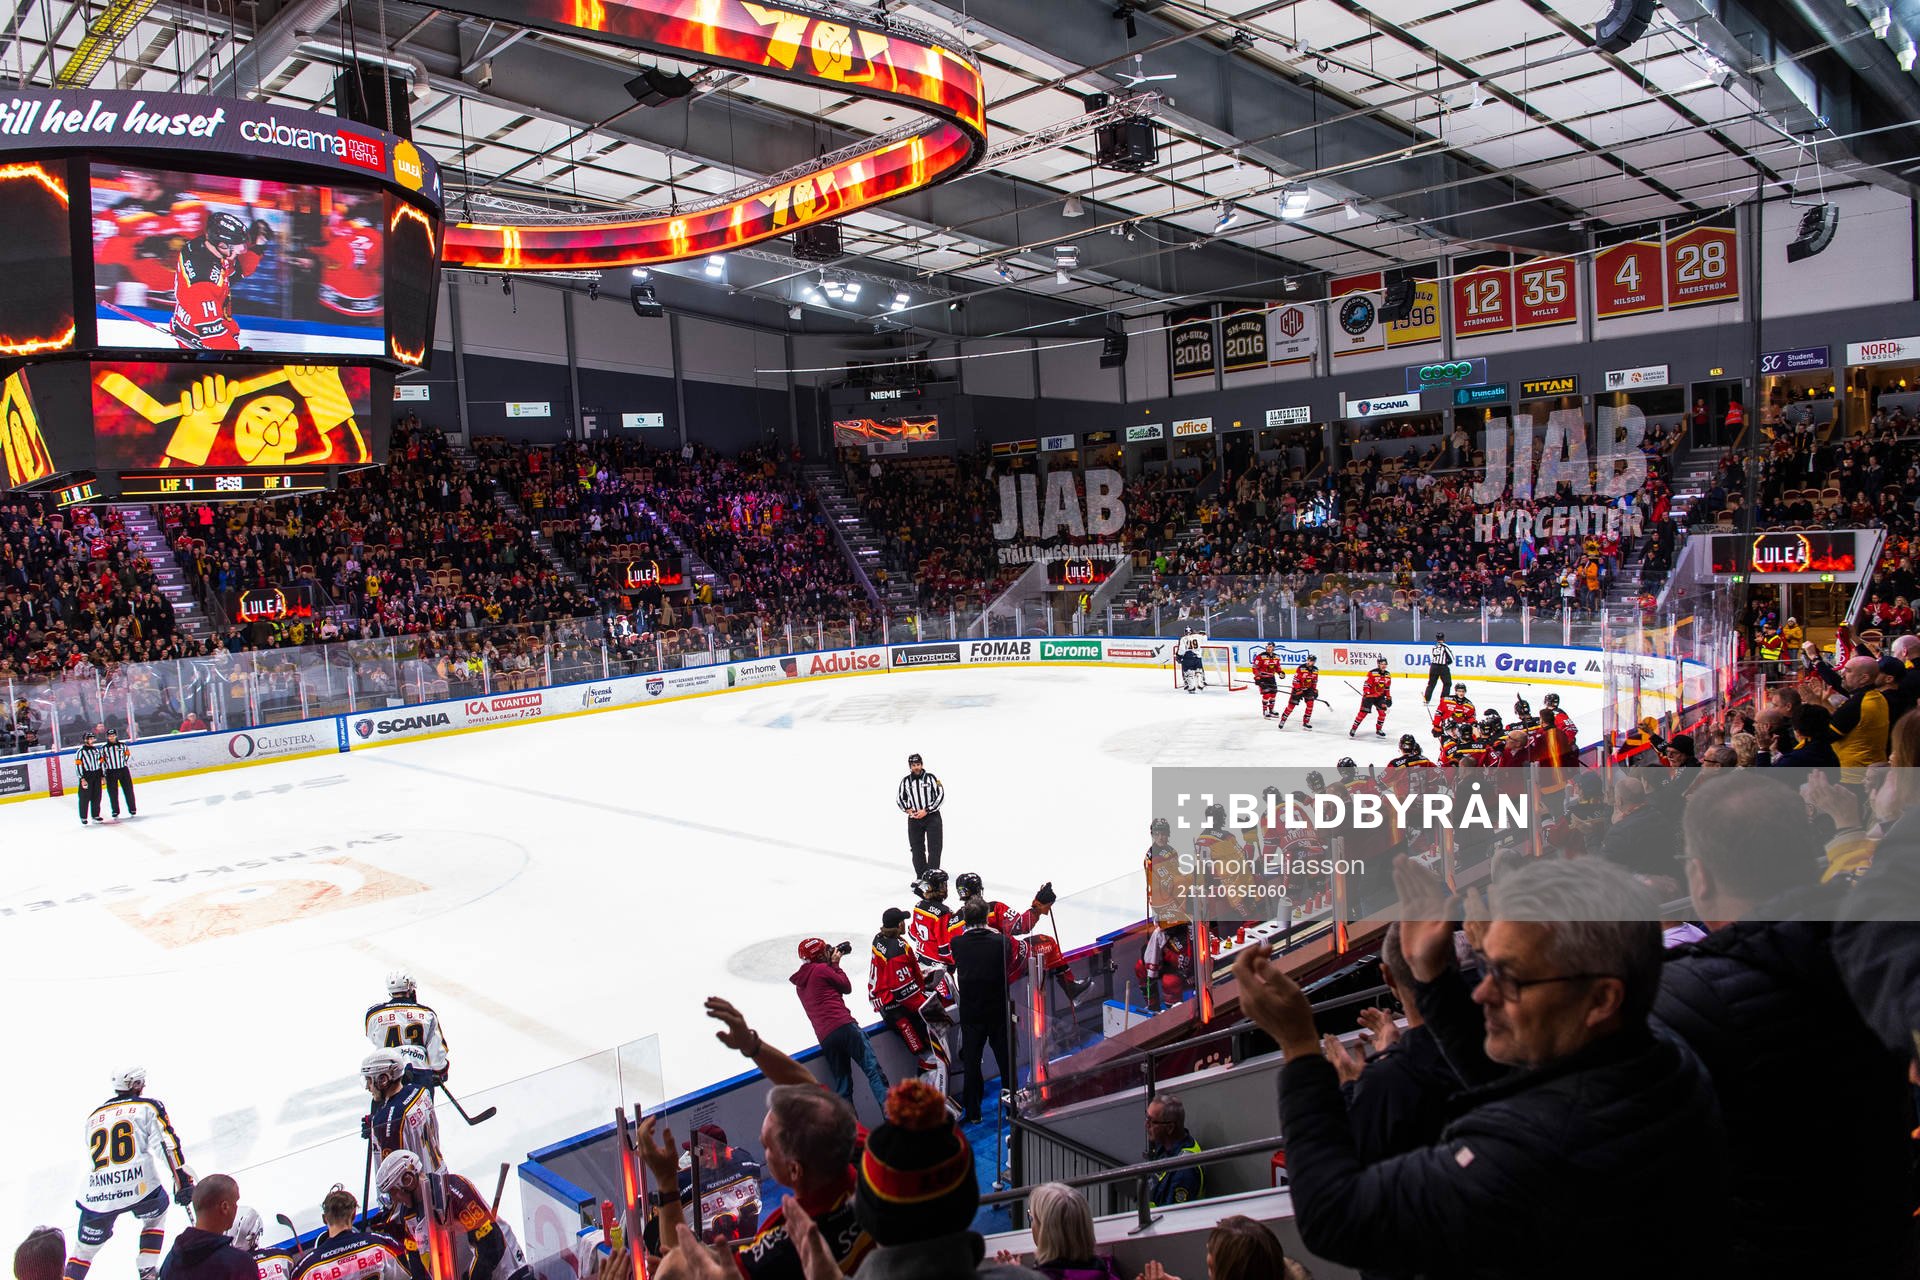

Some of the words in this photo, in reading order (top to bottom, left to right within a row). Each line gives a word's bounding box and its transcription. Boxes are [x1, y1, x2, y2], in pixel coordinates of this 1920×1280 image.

[40, 99, 118, 134] hela
[123, 100, 225, 137] huset
[240, 117, 347, 157] colorama
[1676, 240, 1727, 284] 28
[1615, 255, 1640, 292] 4
[1522, 266, 1568, 307] 35
[1464, 279, 1501, 316] 12
[1613, 294, 1646, 305] NILSSON
[201, 301, 217, 317] 14
[1532, 307, 1559, 317] MYLLYS
[1226, 321, 1261, 336] SM-GULD
[1281, 308, 1303, 336] CHL
[1345, 319, 1371, 333] TROPHY
[1176, 330, 1209, 344] SM-GULD
[1175, 343, 1212, 366] 2018
[1226, 335, 1264, 358] 2016
[1861, 342, 1896, 356] NORD
[1788, 353, 1814, 361] Student
[1788, 358, 1824, 368] Consulting
[1419, 361, 1472, 380] coop
[422, 389, 428, 397] E
[1471, 387, 1505, 397] truncatis
[1523, 378, 1574, 393] TITAN
[870, 390, 896, 400] NIEMI
[1373, 400, 1409, 411] SCANIA
[583, 416, 597, 438] F
[1176, 421, 1208, 435] office
[1048, 438, 1062, 449] WIST
[1475, 404, 1648, 504] JIAB
[160, 480, 180, 491] LHF
[185, 479, 194, 490] 4
[216, 477, 242, 490] 2:59
[264, 477, 279, 488] DIF
[283, 476, 291, 488] 0
[993, 470, 1126, 540] JIAB
[1475, 506, 1643, 542] HYRCENTER
[997, 542, 1124, 565] STÄLLNINGSMONTAGE
[1755, 540, 1806, 563] LULEÅ
[630, 565, 657, 582] LULEÅ
[1067, 563, 1091, 578] LULEÅ
[242, 593, 283, 615] LULEÅ
[971, 642, 1031, 657] FOMAB
[1044, 643, 1099, 657] Derome
[1350, 652, 1383, 660] SVENSKA
[810, 651, 881, 675] Advise
[1495, 652, 1577, 675] Granec
[591, 687, 612, 697] Svensk
[594, 696, 611, 704] Cater
[465, 701, 489, 716] ICA
[494, 695, 540, 709] KVANTUM
[378, 712, 450, 735] SCANIA
[896, 966, 912, 982] 34
[90, 1119, 136, 1172] 26
[85, 1190, 134, 1202] Sundström
[458, 1199, 486, 1230] 95
[357, 1251, 384, 1269] B2B
